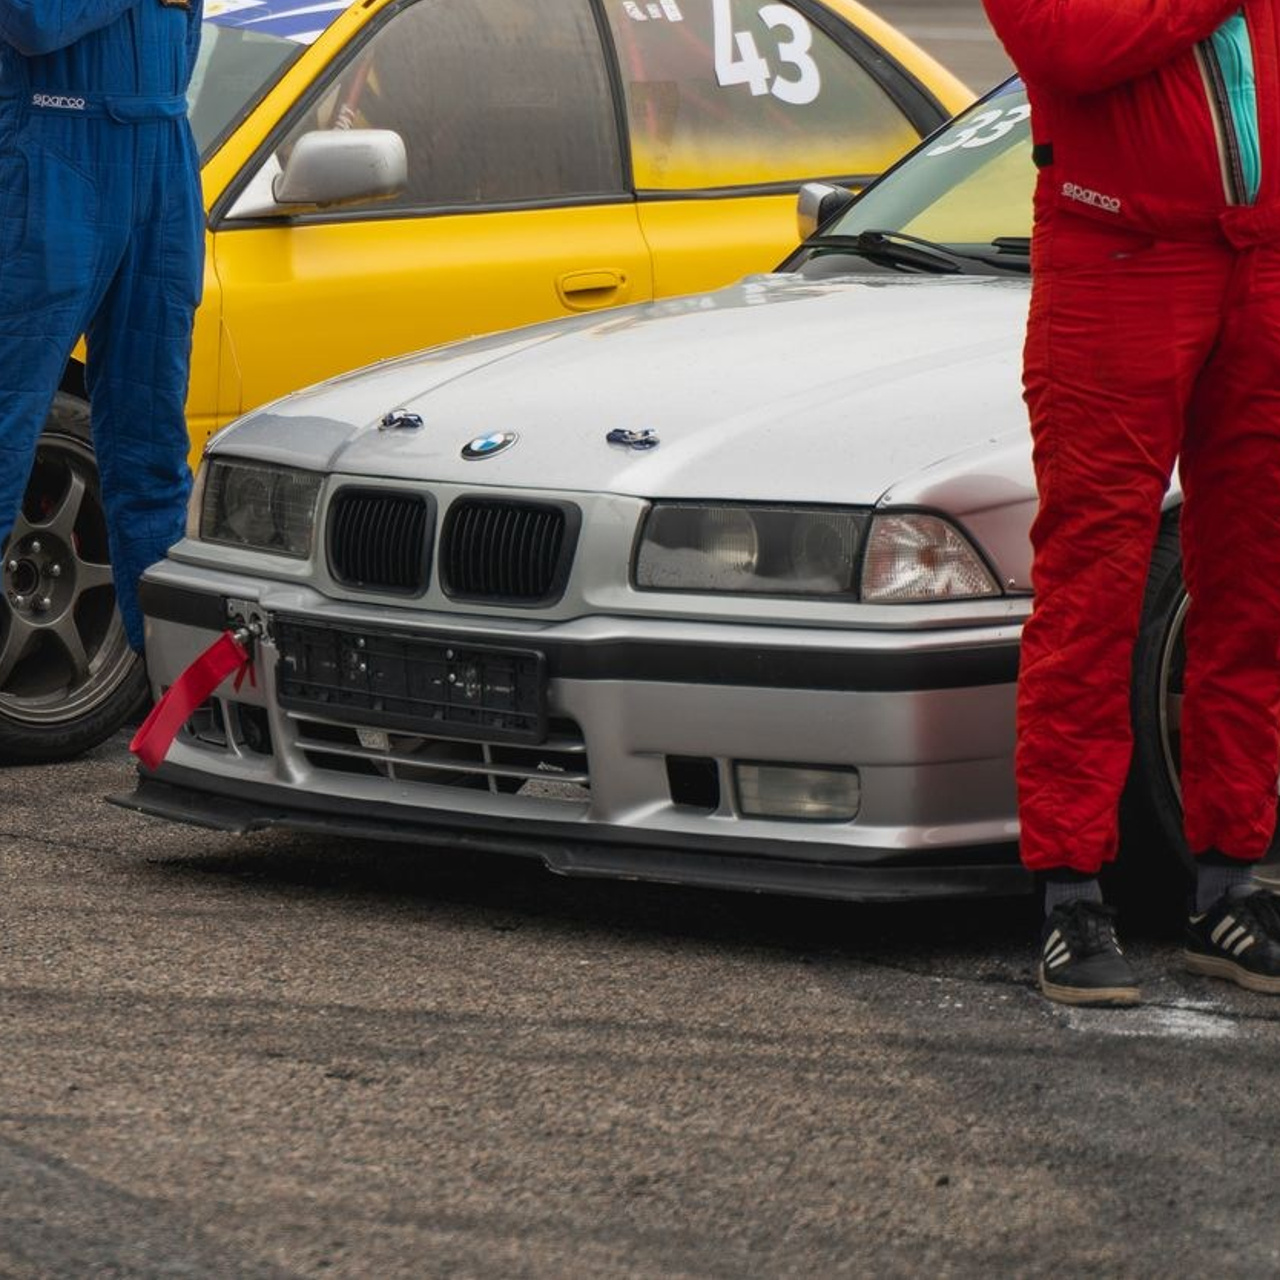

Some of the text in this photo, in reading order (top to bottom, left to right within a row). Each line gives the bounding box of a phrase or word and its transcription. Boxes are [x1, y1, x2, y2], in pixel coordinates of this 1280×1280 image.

[32, 93, 86, 110] sparco
[926, 103, 1032, 156] 33
[1062, 182, 1121, 213] sparco
